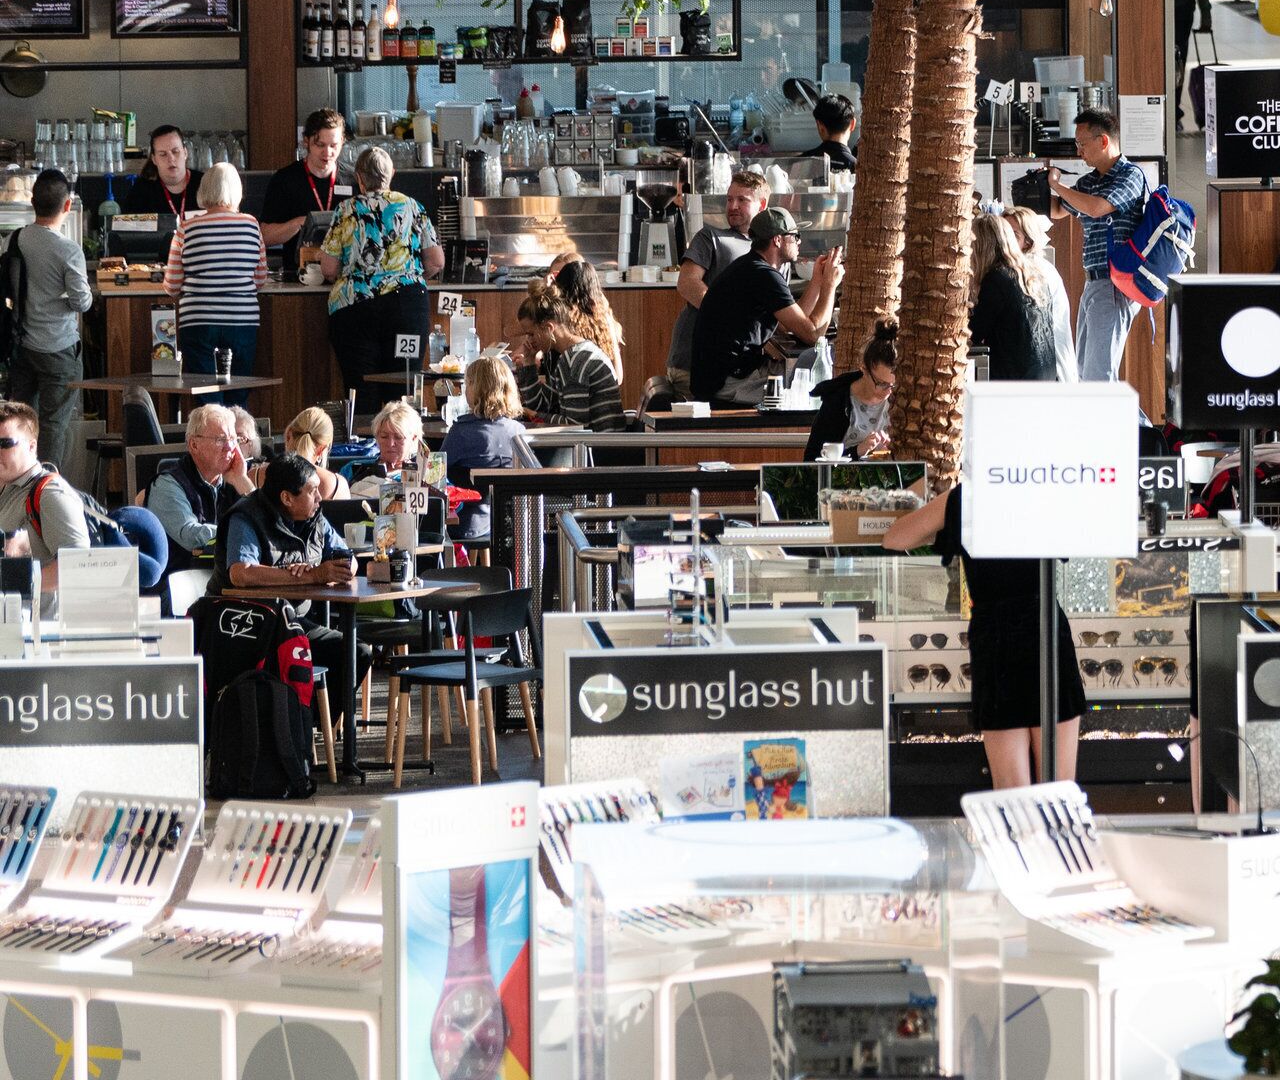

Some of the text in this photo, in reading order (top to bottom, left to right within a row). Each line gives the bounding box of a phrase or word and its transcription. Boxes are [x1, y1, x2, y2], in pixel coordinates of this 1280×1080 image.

[992, 86, 1000, 99] 5
[1027, 85, 1035, 99] 3
[441, 296, 458, 311] 24
[400, 338, 416, 353] 25
[1207, 389, 1274, 411] sunglass
[987, 463, 1097, 485] swatch
[409, 492, 425, 508] 20
[632, 668, 875, 721] sunglass hut
[0, 681, 190, 733] nglass hut
